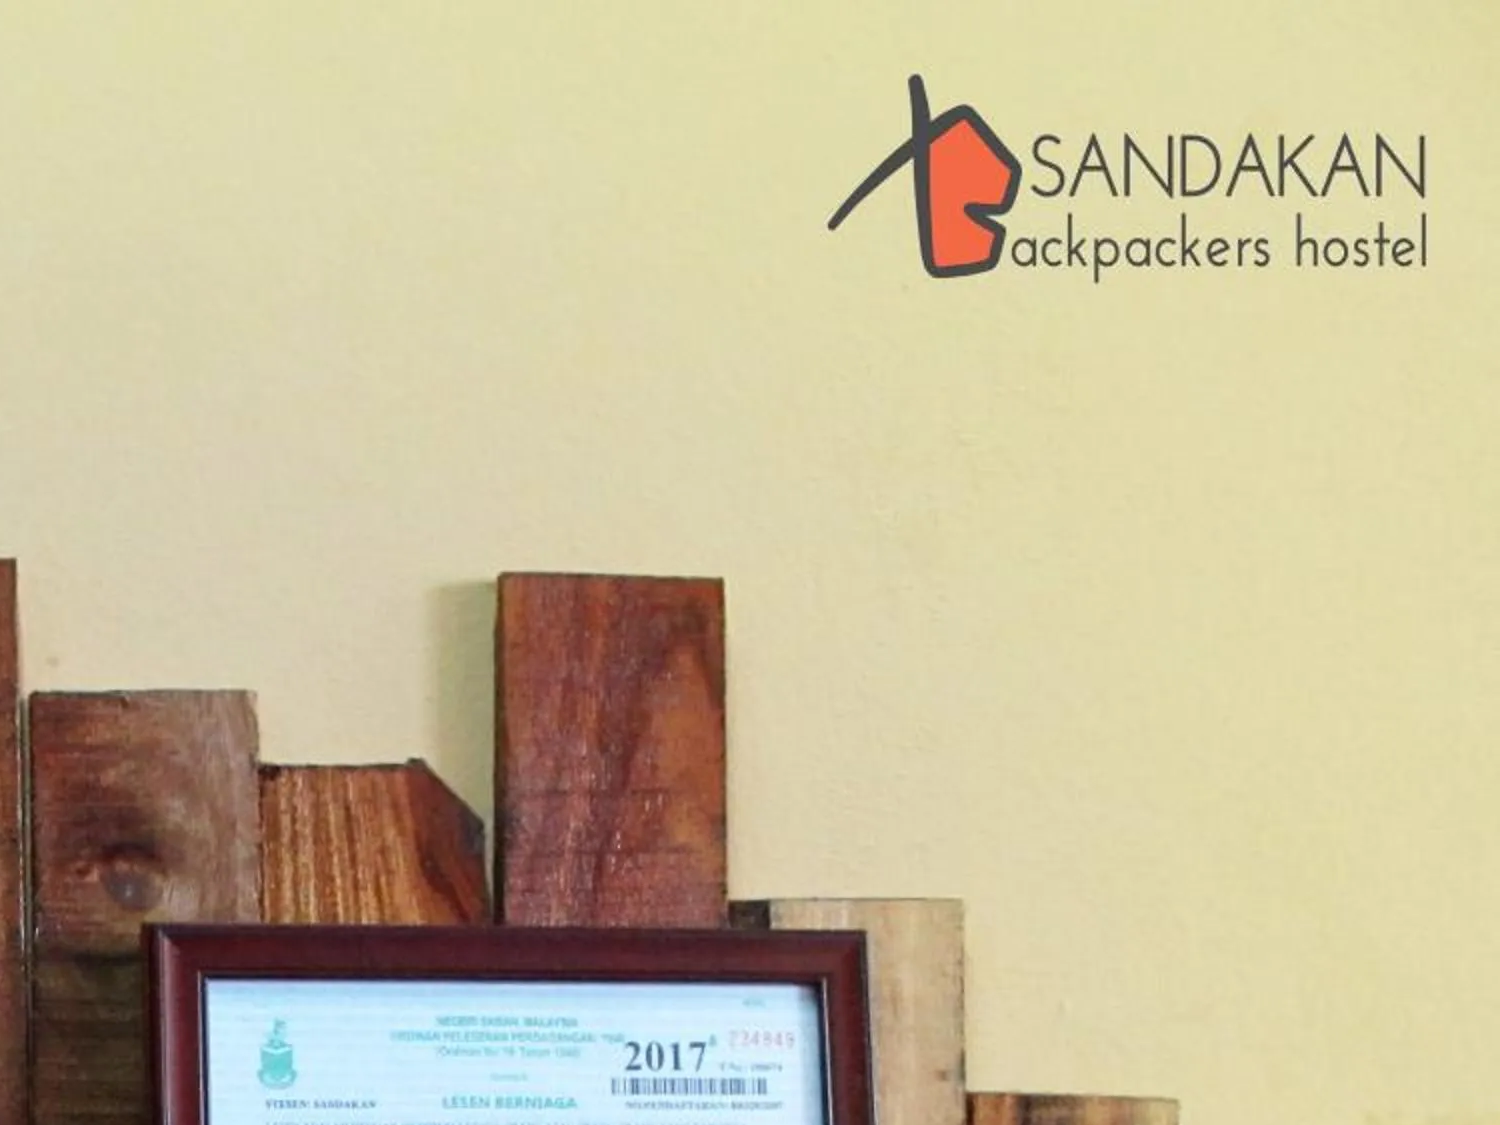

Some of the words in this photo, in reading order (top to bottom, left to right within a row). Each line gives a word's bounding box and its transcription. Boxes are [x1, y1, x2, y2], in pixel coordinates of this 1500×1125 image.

[624, 1041, 707, 1072] 2017
[442, 1096, 490, 1109] LESEN
[494, 1096, 578, 1109] BERNIAGA
